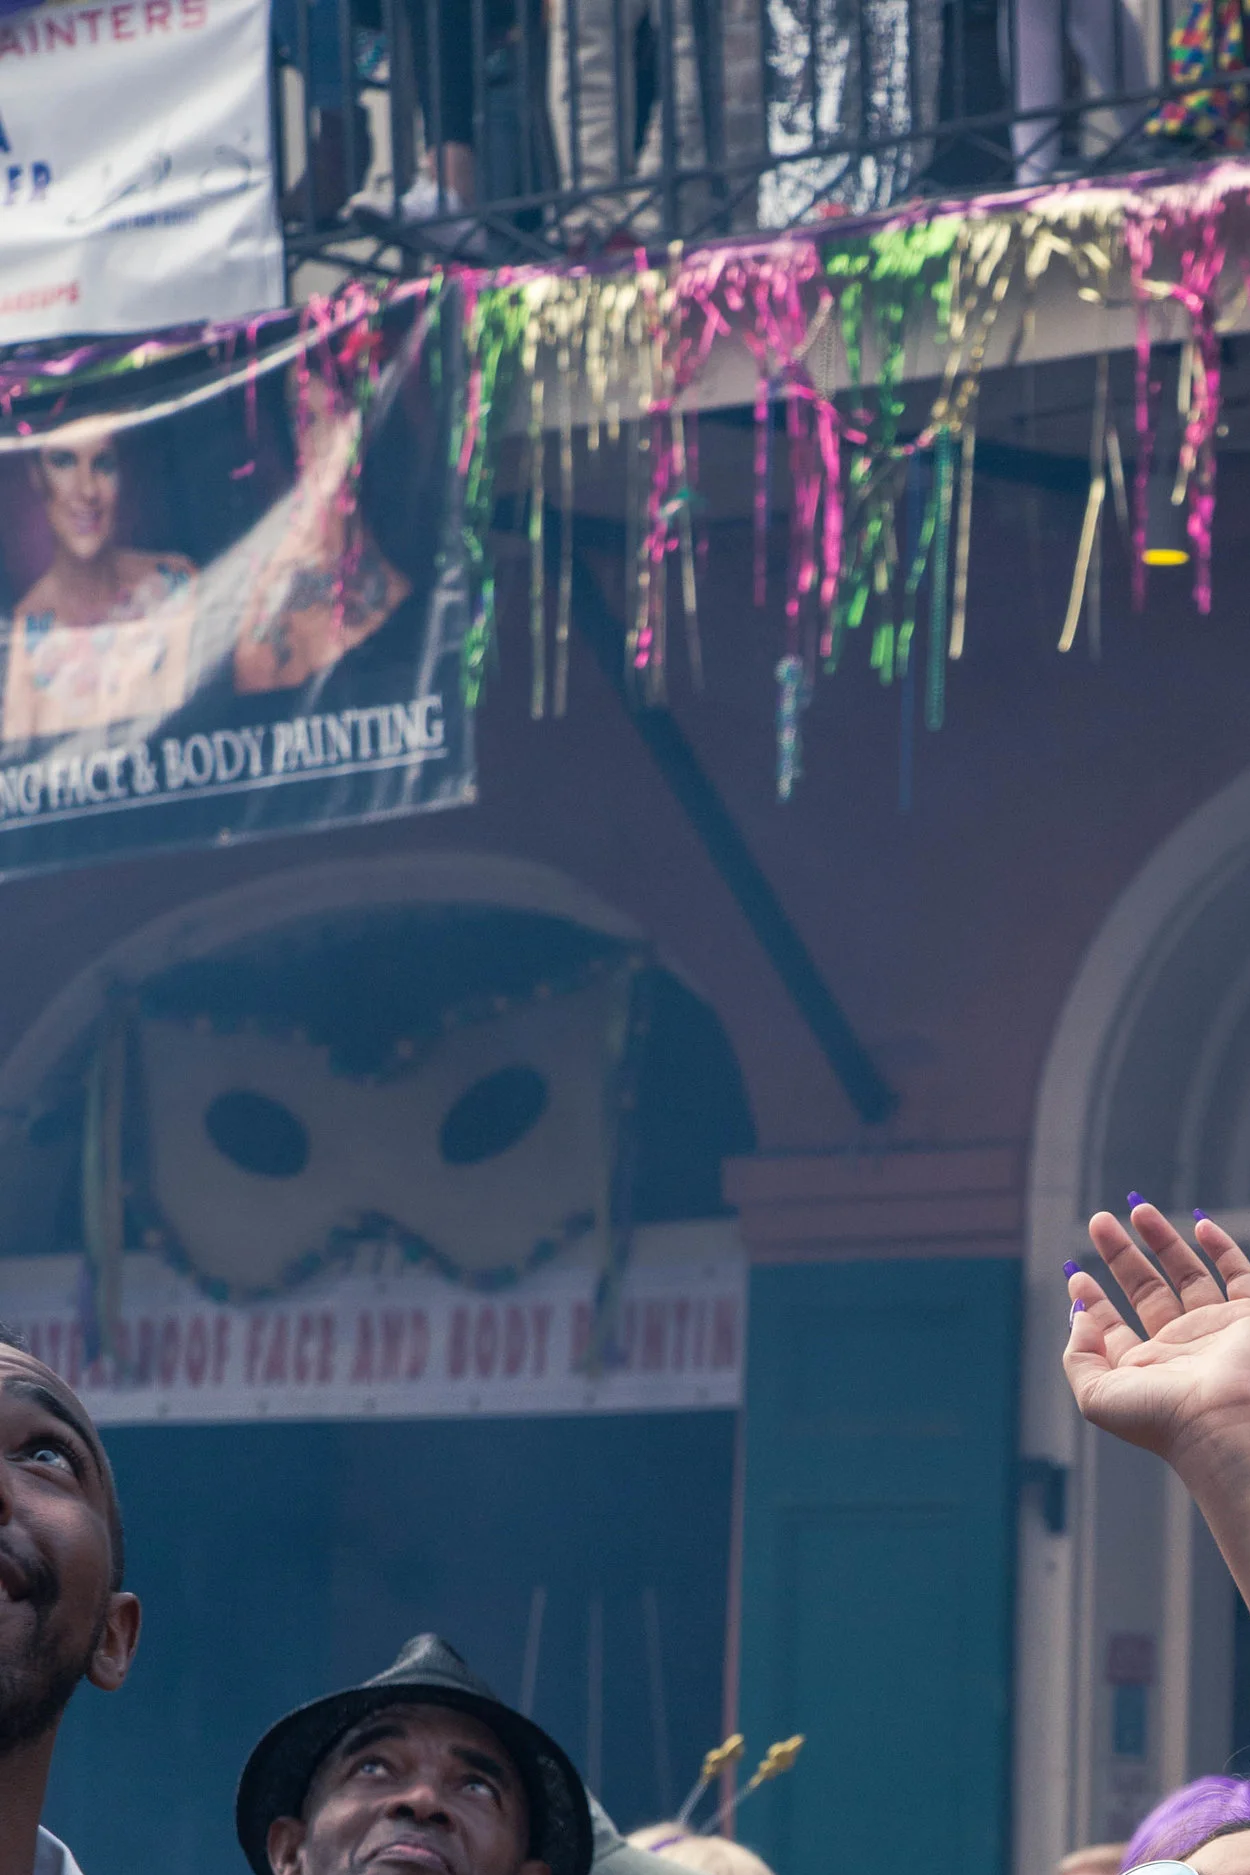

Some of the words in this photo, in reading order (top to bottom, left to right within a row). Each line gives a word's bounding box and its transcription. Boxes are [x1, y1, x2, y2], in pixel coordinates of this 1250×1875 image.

[48, 744, 130, 808] FACE
[132, 743, 158, 797] &
[163, 723, 266, 788] BODY
[272, 694, 444, 772] PAINTING
[349, 1304, 429, 1384] AND
[446, 1302, 553, 1380] BODY
